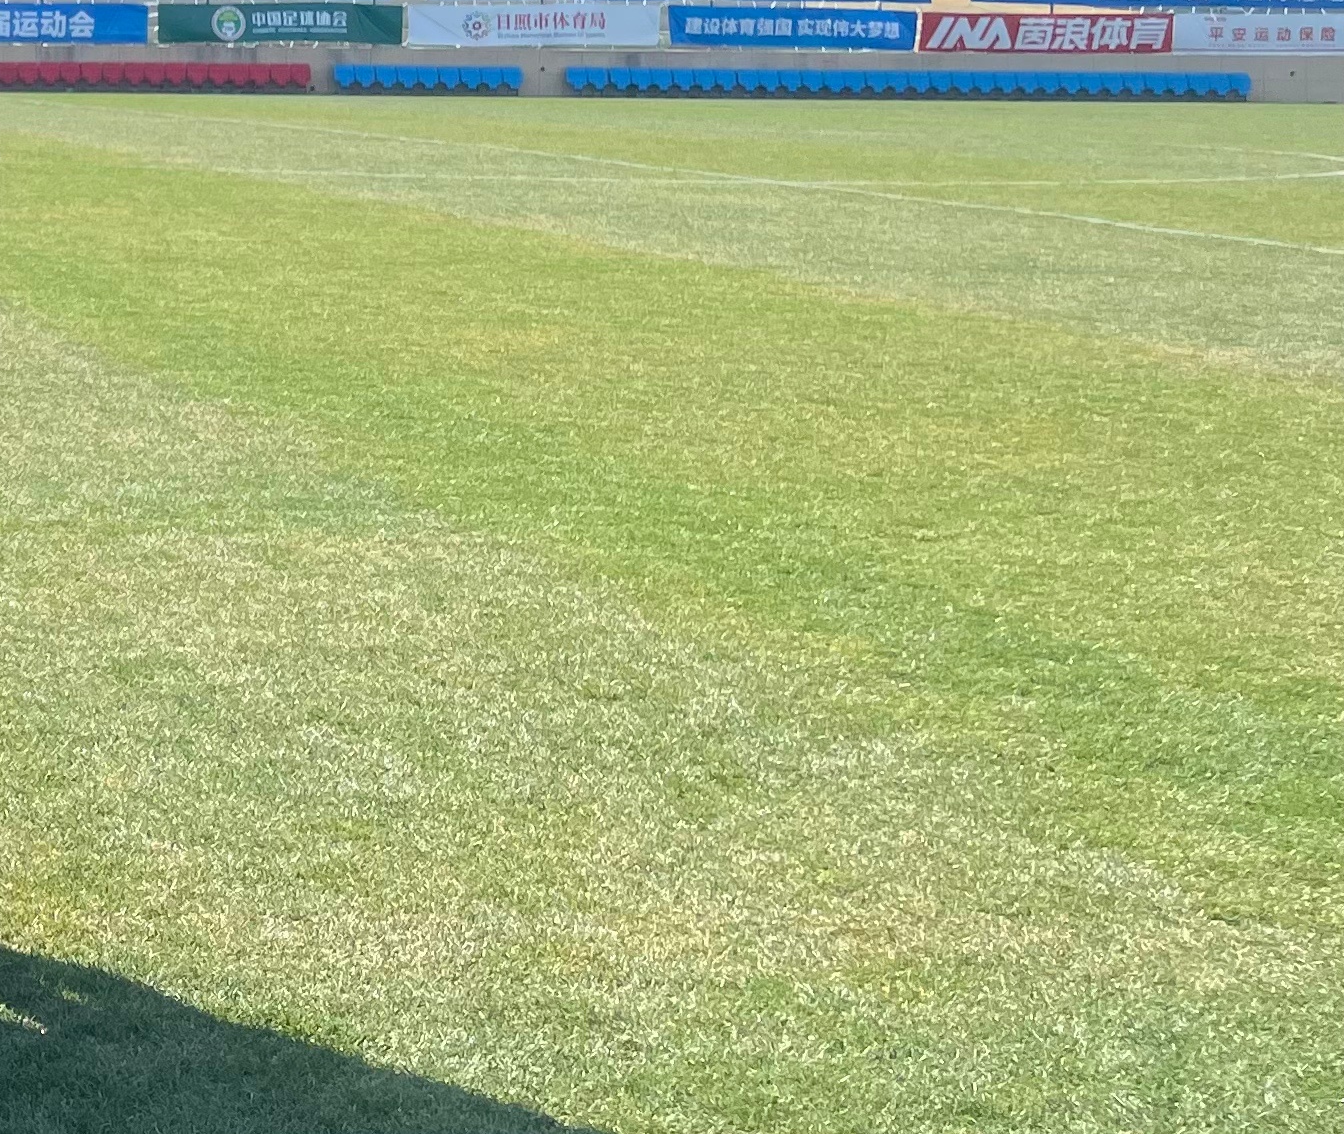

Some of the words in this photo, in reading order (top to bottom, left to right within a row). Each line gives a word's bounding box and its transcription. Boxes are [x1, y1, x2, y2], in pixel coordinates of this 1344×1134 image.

[252, 10, 347, 27] 中国足球协会
[497, 12, 606, 30] 日照市体育局
[685, 17, 793, 36] 建设体育强国
[1015, 18, 1169, 51] 茵浪体育
